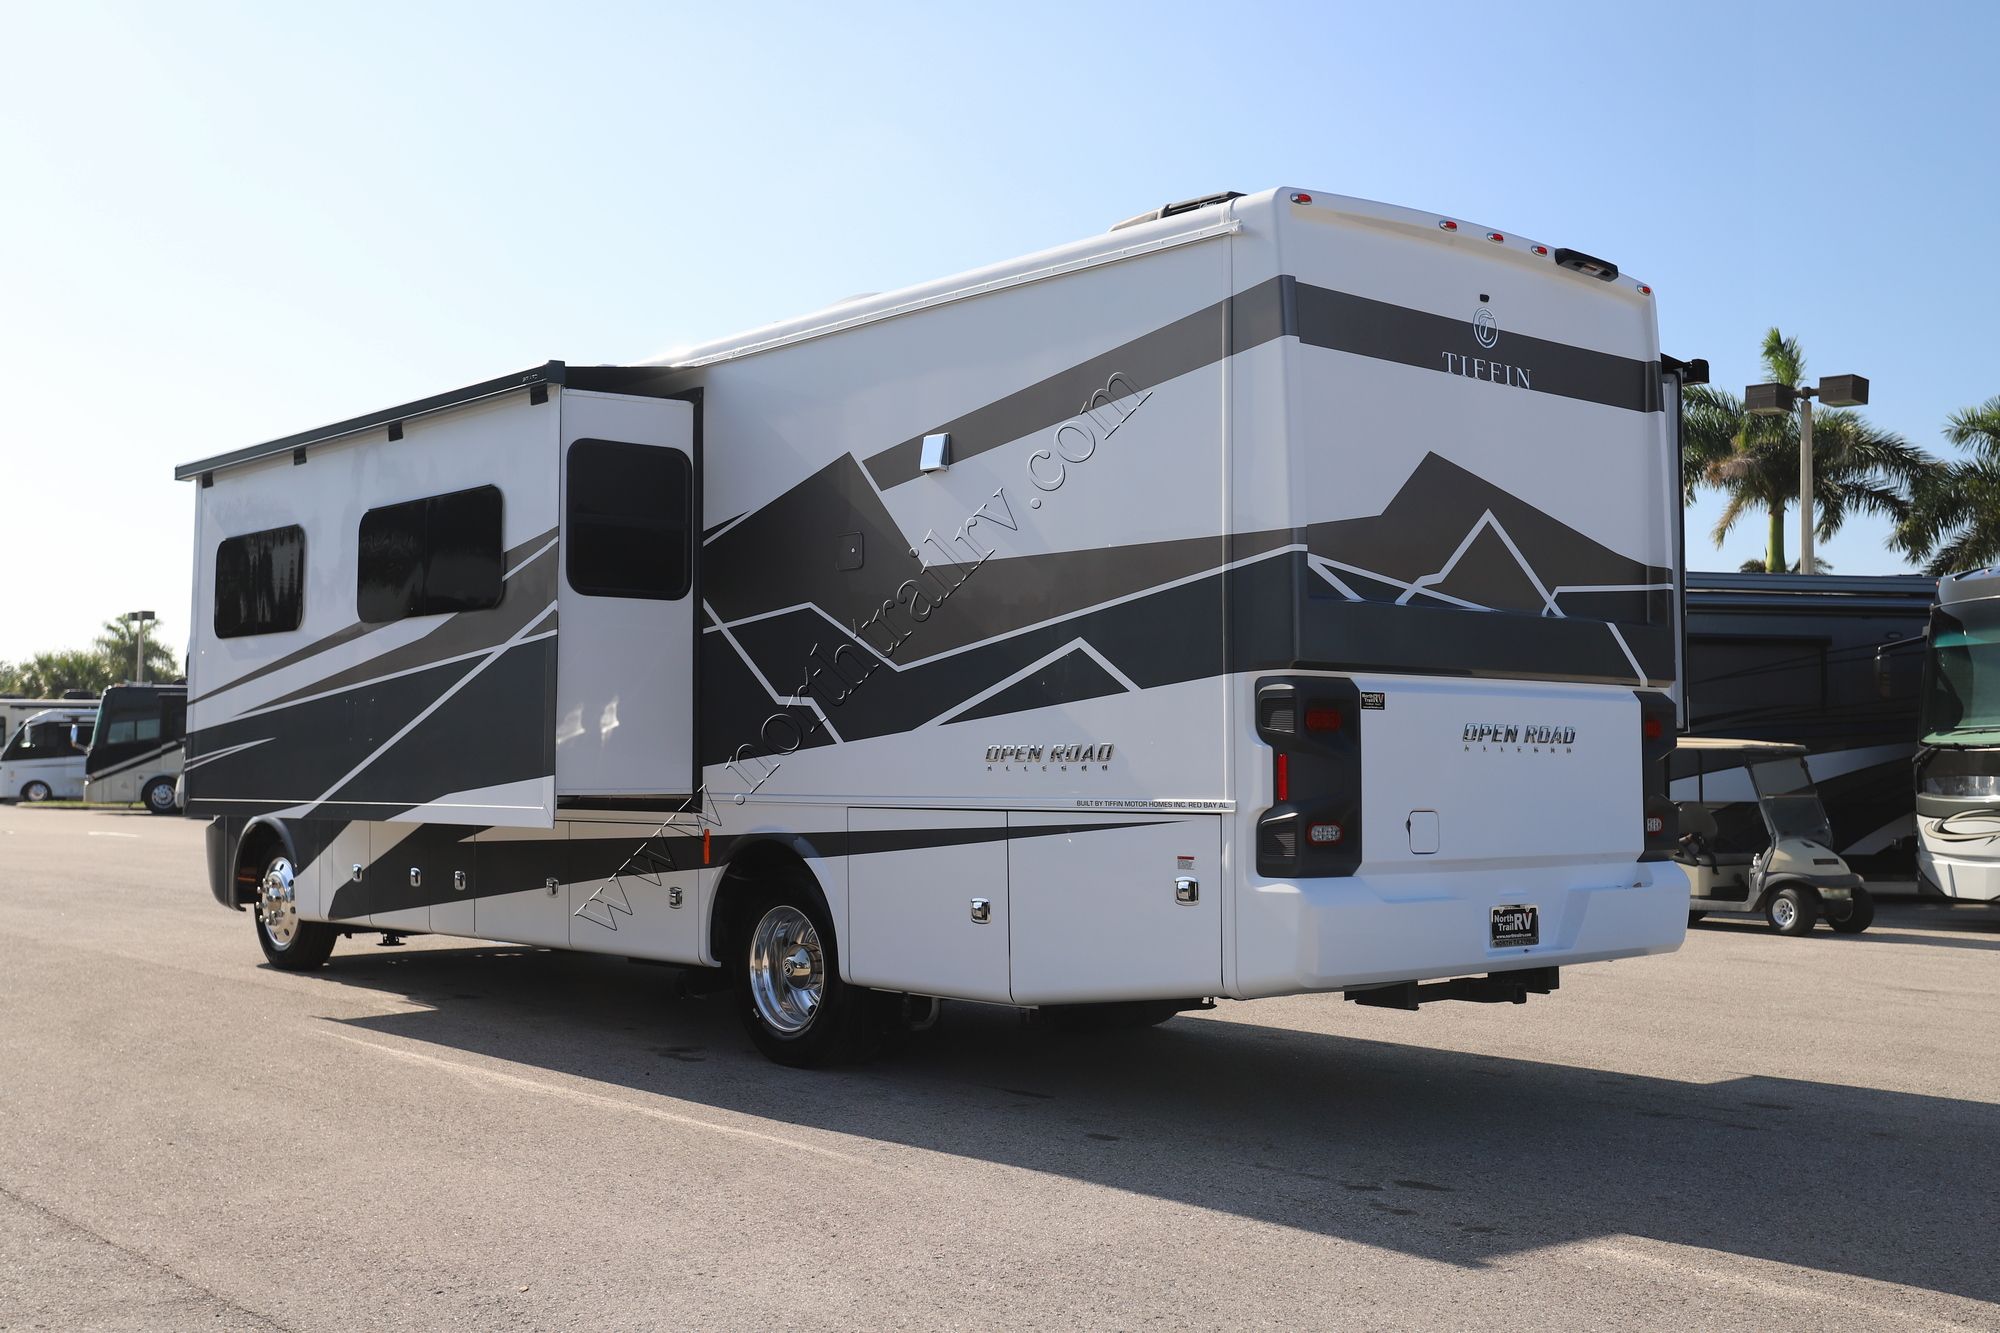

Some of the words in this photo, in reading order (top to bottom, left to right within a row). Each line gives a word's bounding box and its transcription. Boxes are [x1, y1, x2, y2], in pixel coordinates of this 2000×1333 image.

[1442, 351, 1532, 389] TIFFIN
[1463, 723, 1520, 743] OPEN
[1524, 725, 1576, 744] ROAD
[985, 744, 1044, 763] OPEN
[1049, 742, 1114, 763] ROAD
[1494, 914, 1514, 923] North
[1498, 923, 1514, 931] Trail
[1513, 913, 1533, 930] RV
